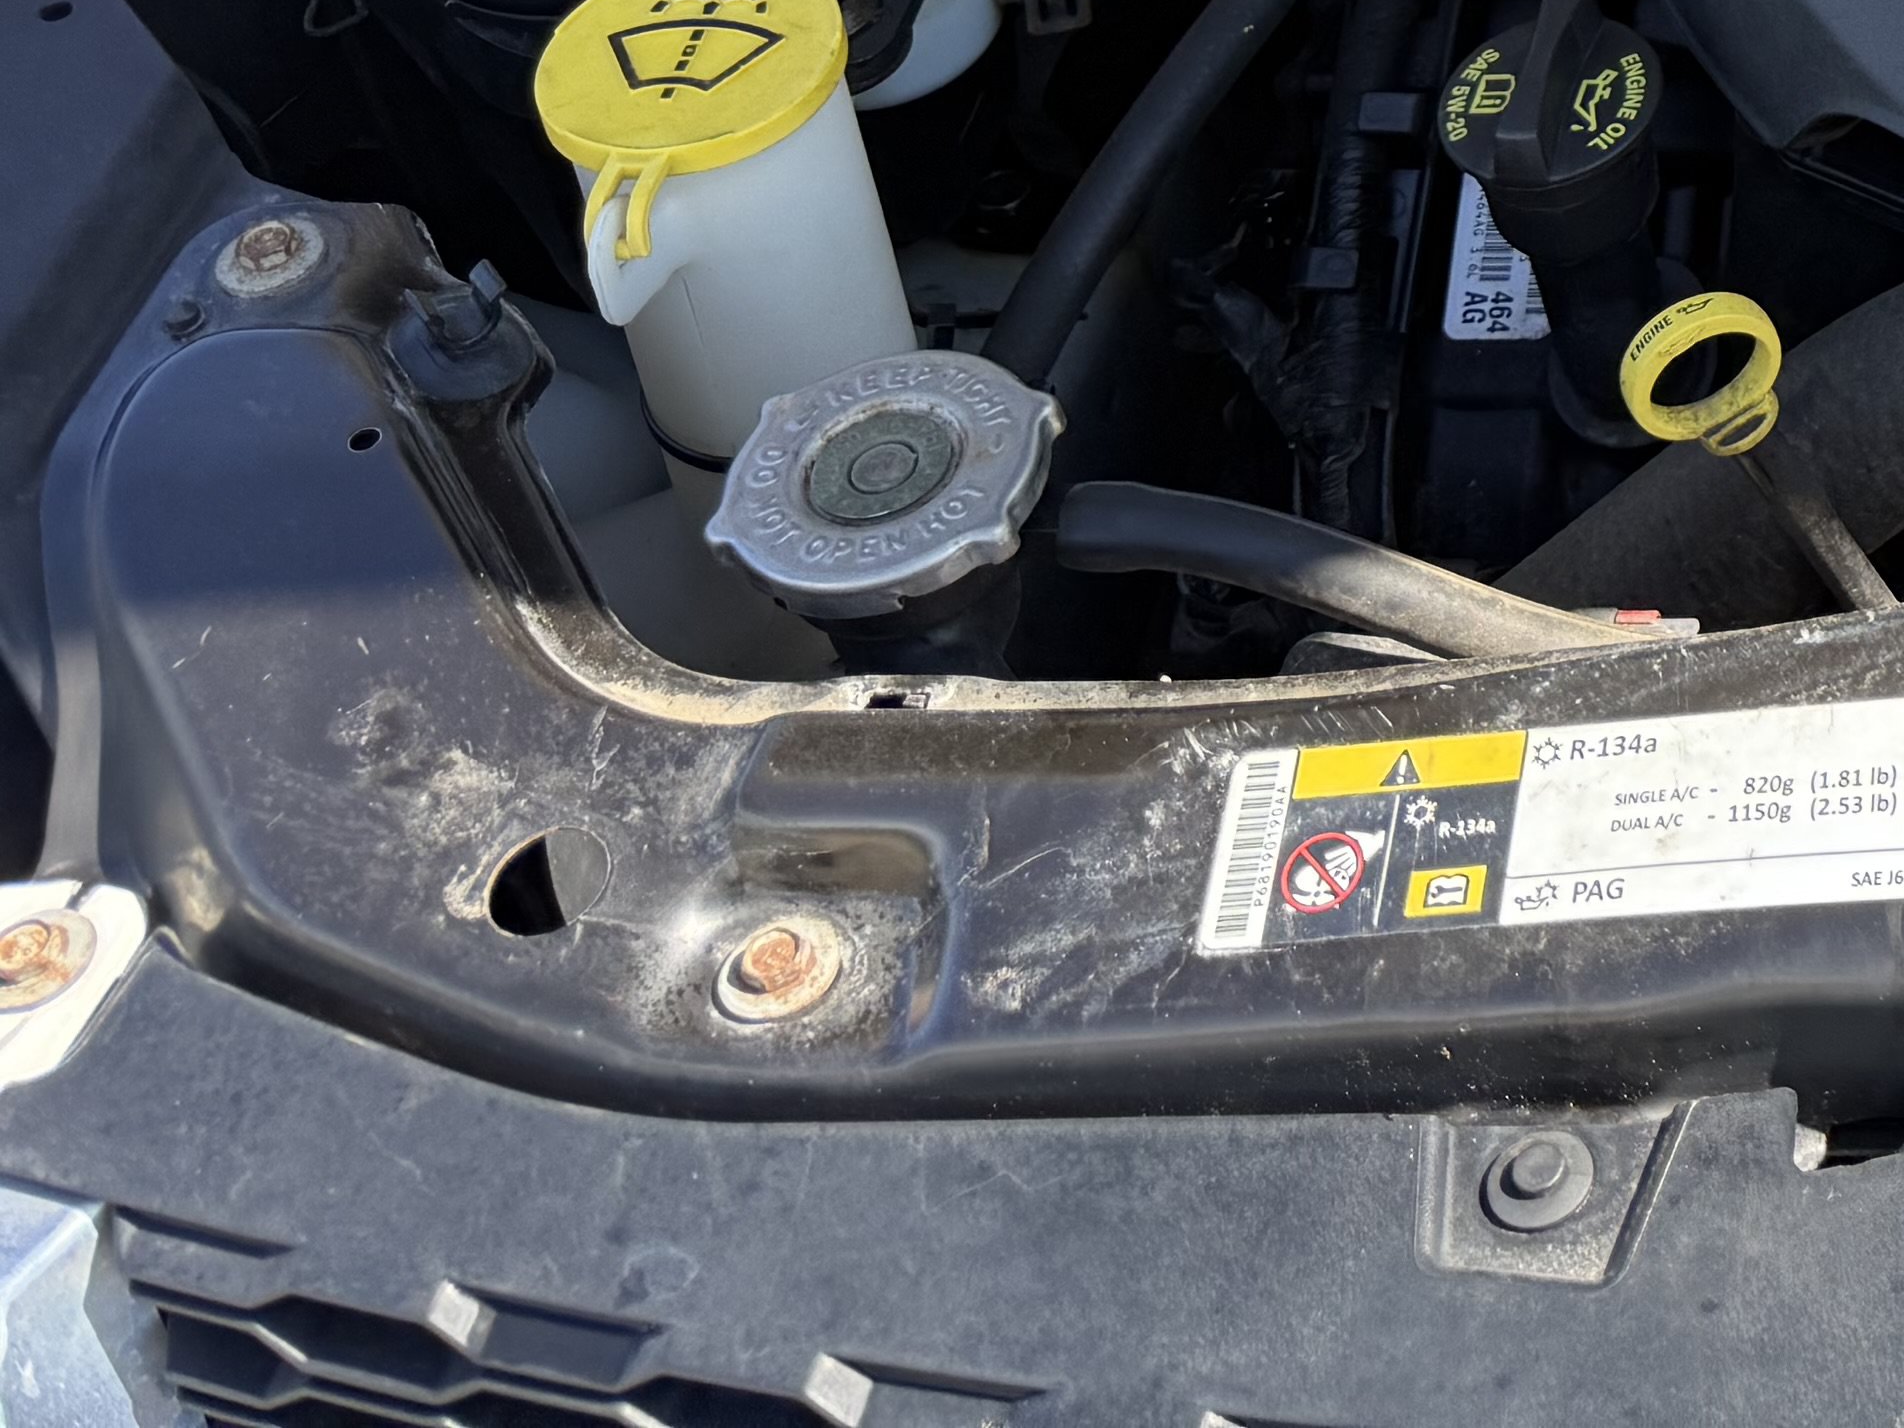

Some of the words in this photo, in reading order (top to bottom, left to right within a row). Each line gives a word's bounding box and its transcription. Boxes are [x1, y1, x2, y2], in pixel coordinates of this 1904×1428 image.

[1460, 48, 1500, 82] SAE
[1616, 53, 1647, 121] ENGINE
[1445, 85, 1471, 142] 5W-20
[1586, 122, 1627, 151] OIL
[1462, 292, 1488, 324] AG
[1487, 291, 1514, 333] 464
[1630, 315, 1673, 362] ENGINE
[825, 365, 932, 407] KEEP
[943, 368, 1012, 426] TIGHT
[746, 448, 788, 489] DO
[747, 497, 801, 546] NOT
[919, 488, 985, 538] HOT
[802, 532, 908, 564] OPEN
[1570, 734, 1657, 761] R-134a
[1614, 789, 1667, 806] SINGLE
[1671, 785, 1699, 803] A/C
[1743, 775, 1795, 796] 820g
[1810, 770, 1863, 794] (1.81
[1870, 765, 1898, 789] lb)
[1610, 815, 1650, 833] DUAL
[1655, 813, 1684, 831] A/C
[1728, 802, 1792, 824] 1150g
[1810, 797, 1864, 822] (2.53
[1870, 791, 1898, 816] lb)
[1253, 786, 1288, 907] P68190190AA
[1572, 878, 1625, 904] PAG
[1851, 870, 1884, 888] SAE
